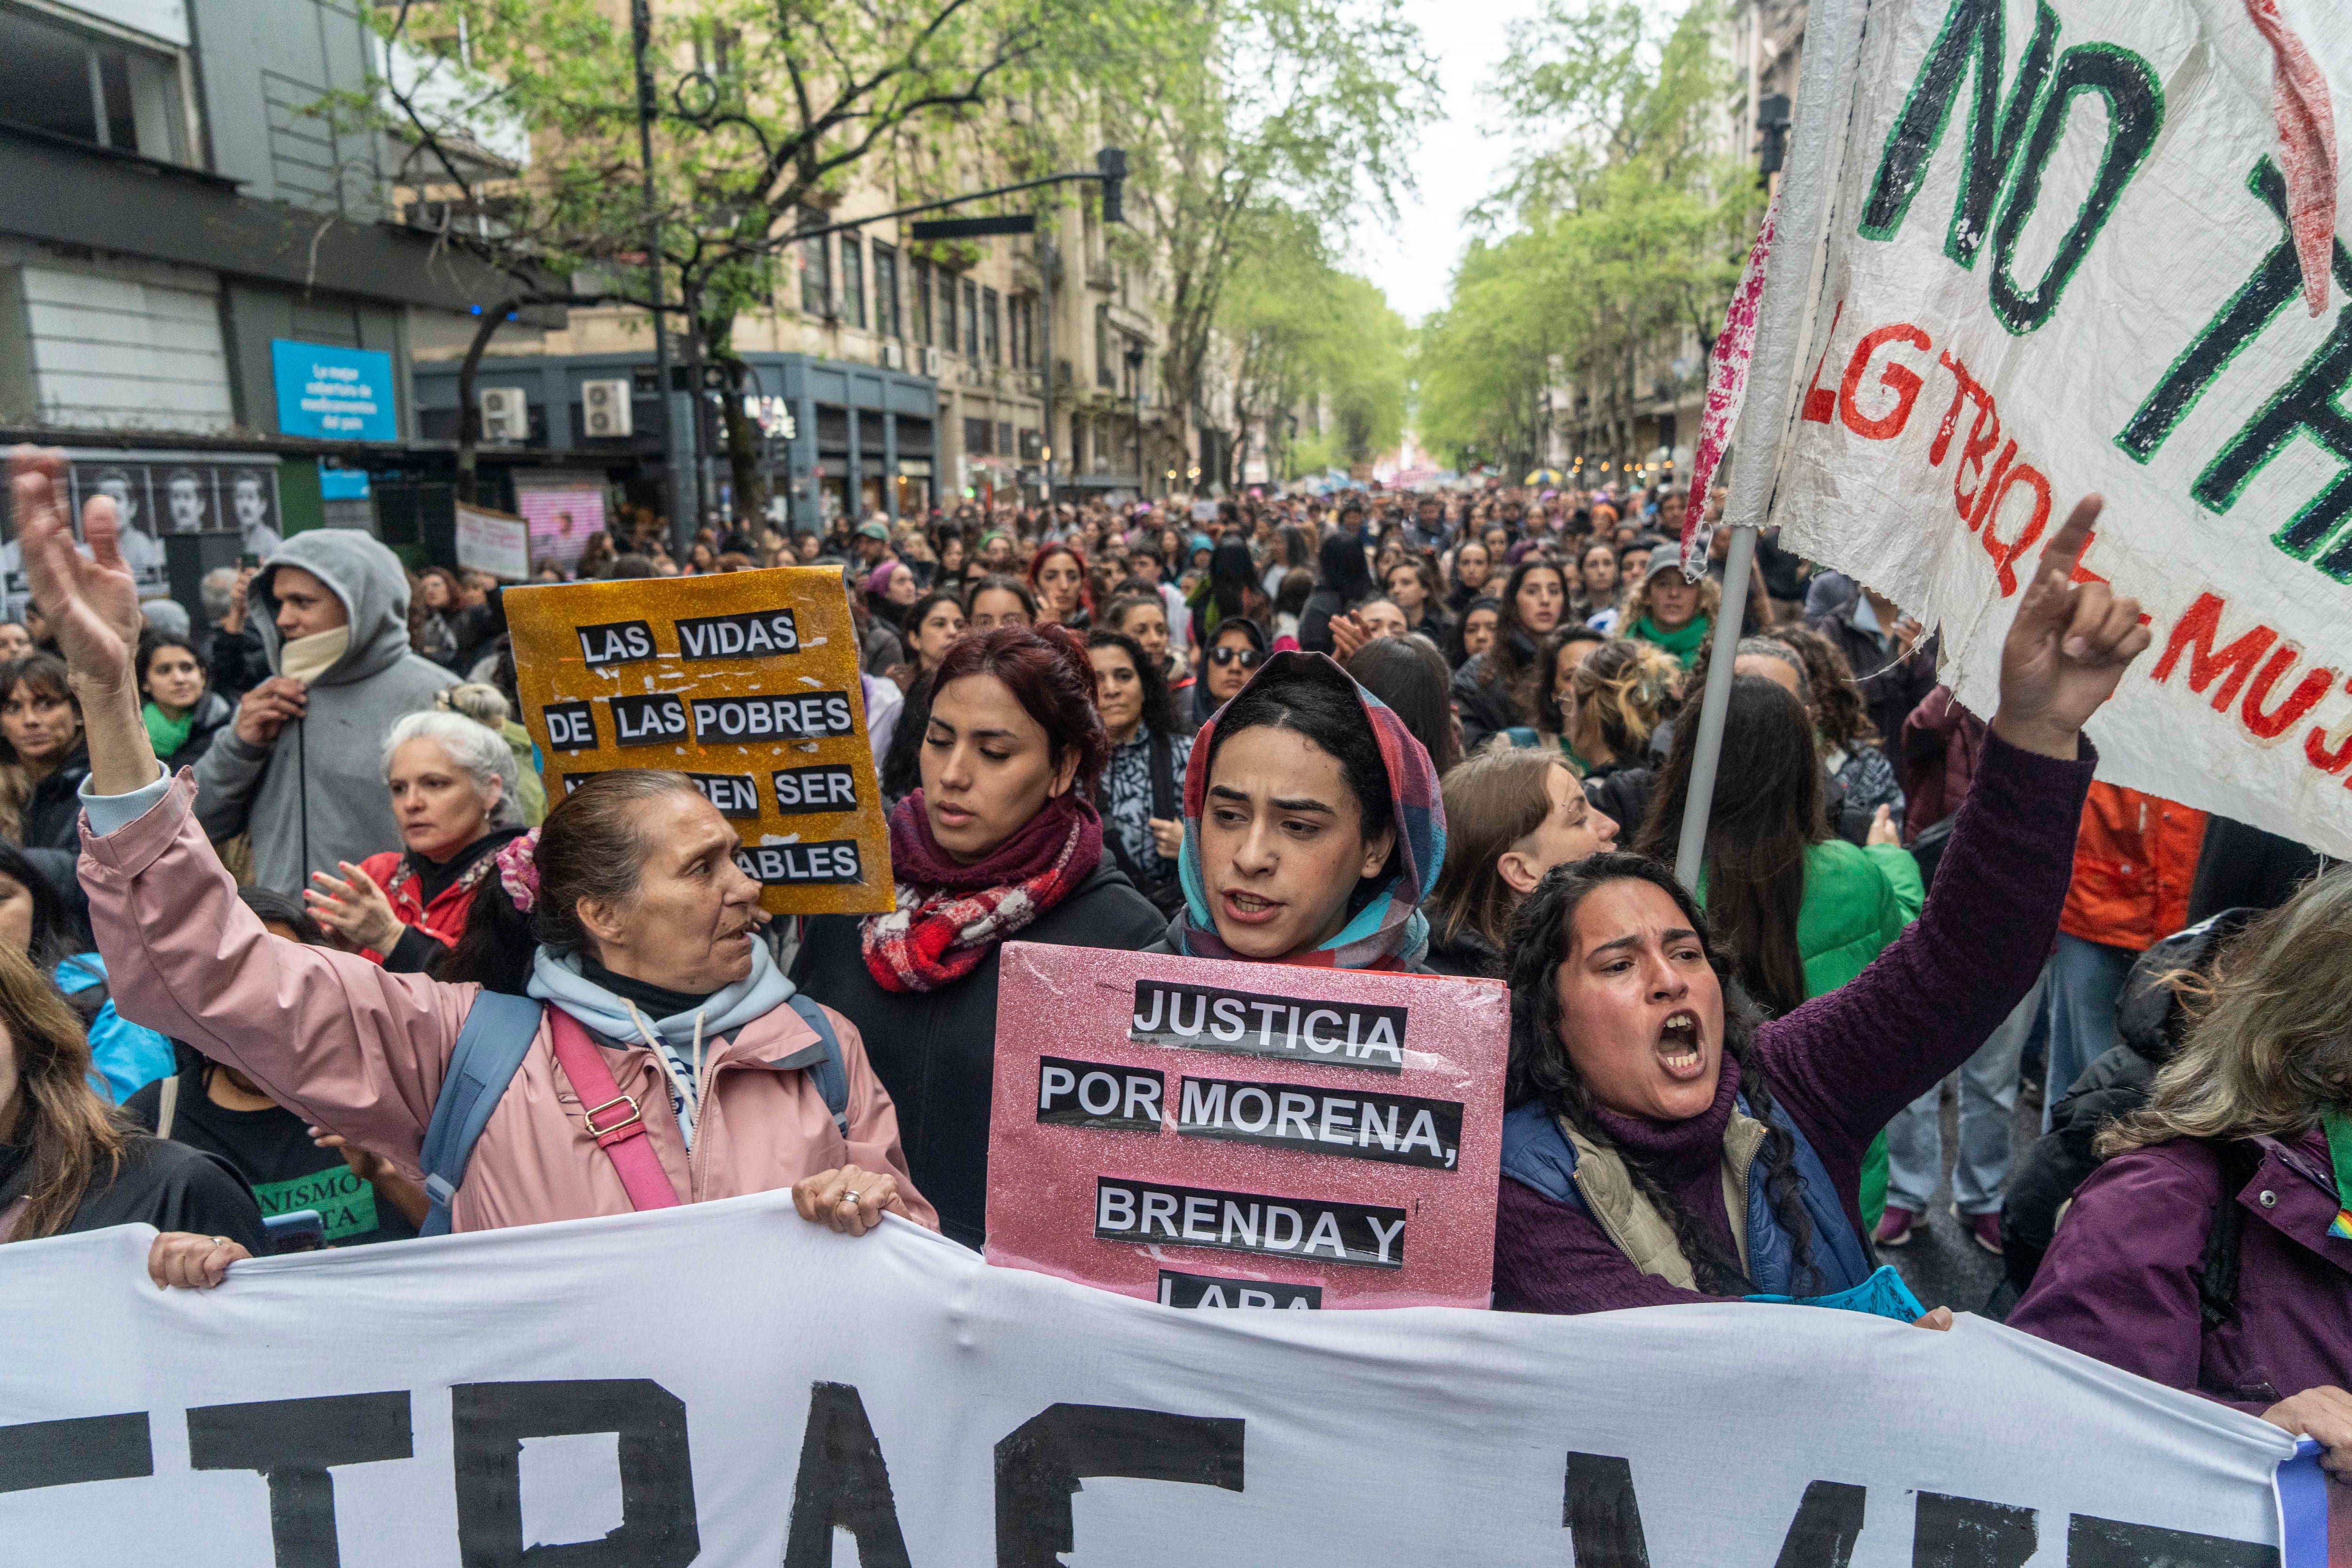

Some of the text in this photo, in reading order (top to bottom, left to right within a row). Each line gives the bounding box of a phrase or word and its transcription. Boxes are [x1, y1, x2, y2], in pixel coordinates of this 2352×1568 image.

[1857, 0, 2167, 337] NO
[580, 616, 796, 663] LAS VIDAS
[547, 698, 851, 744] DE LAS POBRES
[2150, 591, 2352, 791] MUJ
[776, 773, 856, 806] SER
[1133, 989, 1402, 1063] JUSTICIA
[1040, 1067, 1456, 1169] POR MORENA,
[1098, 1187, 1405, 1262] BRENDA Y
[1160, 1278, 1310, 1309] LAR
